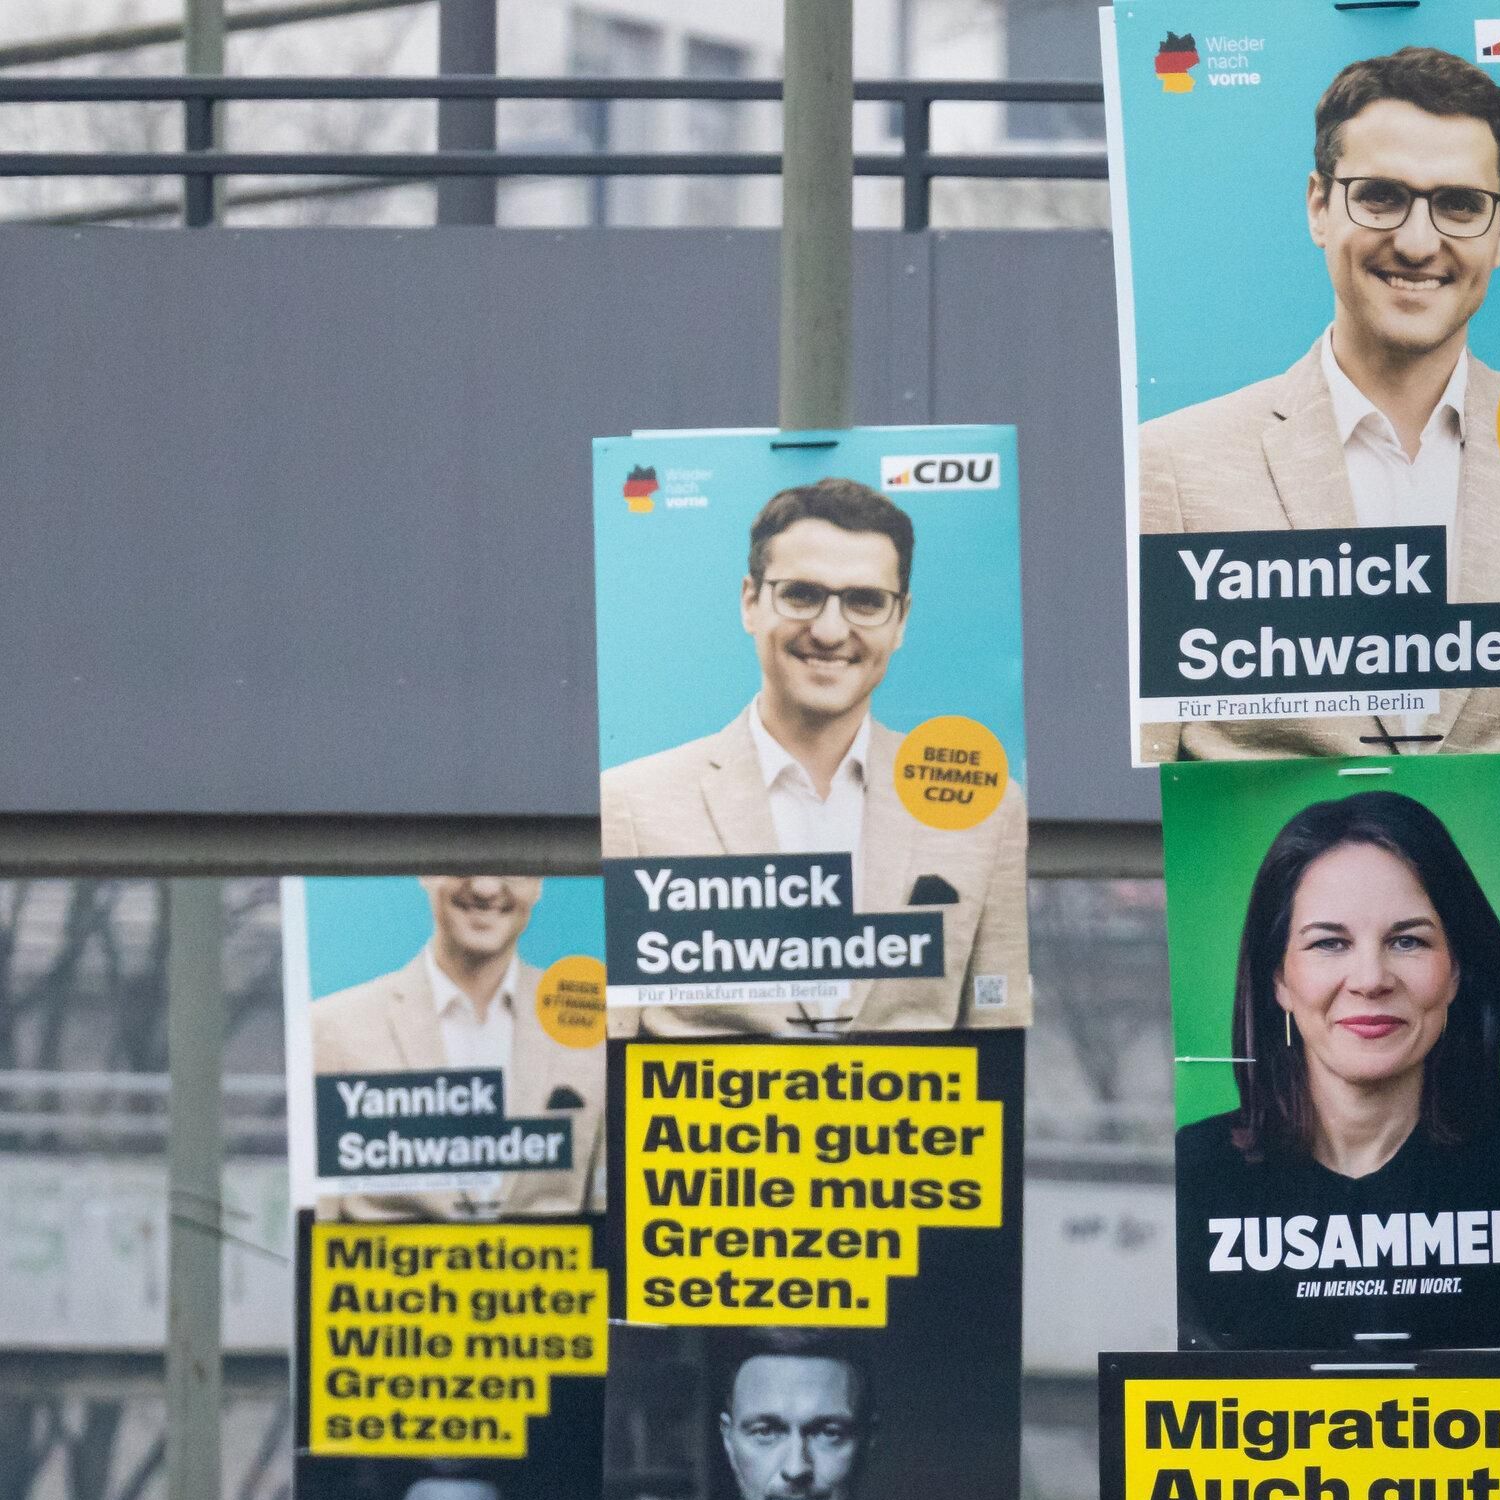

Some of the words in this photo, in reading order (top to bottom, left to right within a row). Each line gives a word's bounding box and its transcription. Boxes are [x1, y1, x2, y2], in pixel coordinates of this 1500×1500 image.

[1205, 36, 1265, 52] Wieder
[1208, 54, 1248, 69] nach
[1208, 70, 1260, 86] vorne
[913, 459, 993, 484] CDU
[1179, 543, 1431, 600] Yannick
[1178, 699, 1211, 718] Für
[1216, 697, 1309, 716] Frankfurt
[1315, 695, 1361, 713] nach
[1367, 692, 1425, 711] Berlin
[923, 747, 980, 767] BEIDE
[903, 765, 998, 788] STIMMEN
[924, 785, 974, 805] CDU
[634, 865, 840, 913] Yannick
[636, 926, 932, 975] Schwander
[336, 1077, 497, 1119] Yannick
[641, 1060, 961, 1109] Migration:
[338, 1130, 565, 1170] Schwander
[642, 1113, 800, 1154] Auch
[815, 1118, 984, 1163] guter
[644, 1167, 794, 1209] Wille
[810, 1177, 982, 1210] muss
[326, 1237, 578, 1277] Migration:
[642, 1218, 901, 1259] Grenzen
[329, 1282, 458, 1315] Auch
[470, 1287, 596, 1322] guter
[643, 1271, 870, 1310] setzen.
[1296, 1281, 1320, 1298] EIN
[1324, 1279, 1388, 1297] MENSCH.
[1393, 1278, 1416, 1295] EIN
[1420, 1276, 1462, 1294] WORT.
[328, 1325, 452, 1359] Wille
[465, 1333, 594, 1360] muss
[325, 1367, 536, 1400] Grenzen
[325, 1412, 512, 1443] setzen.
